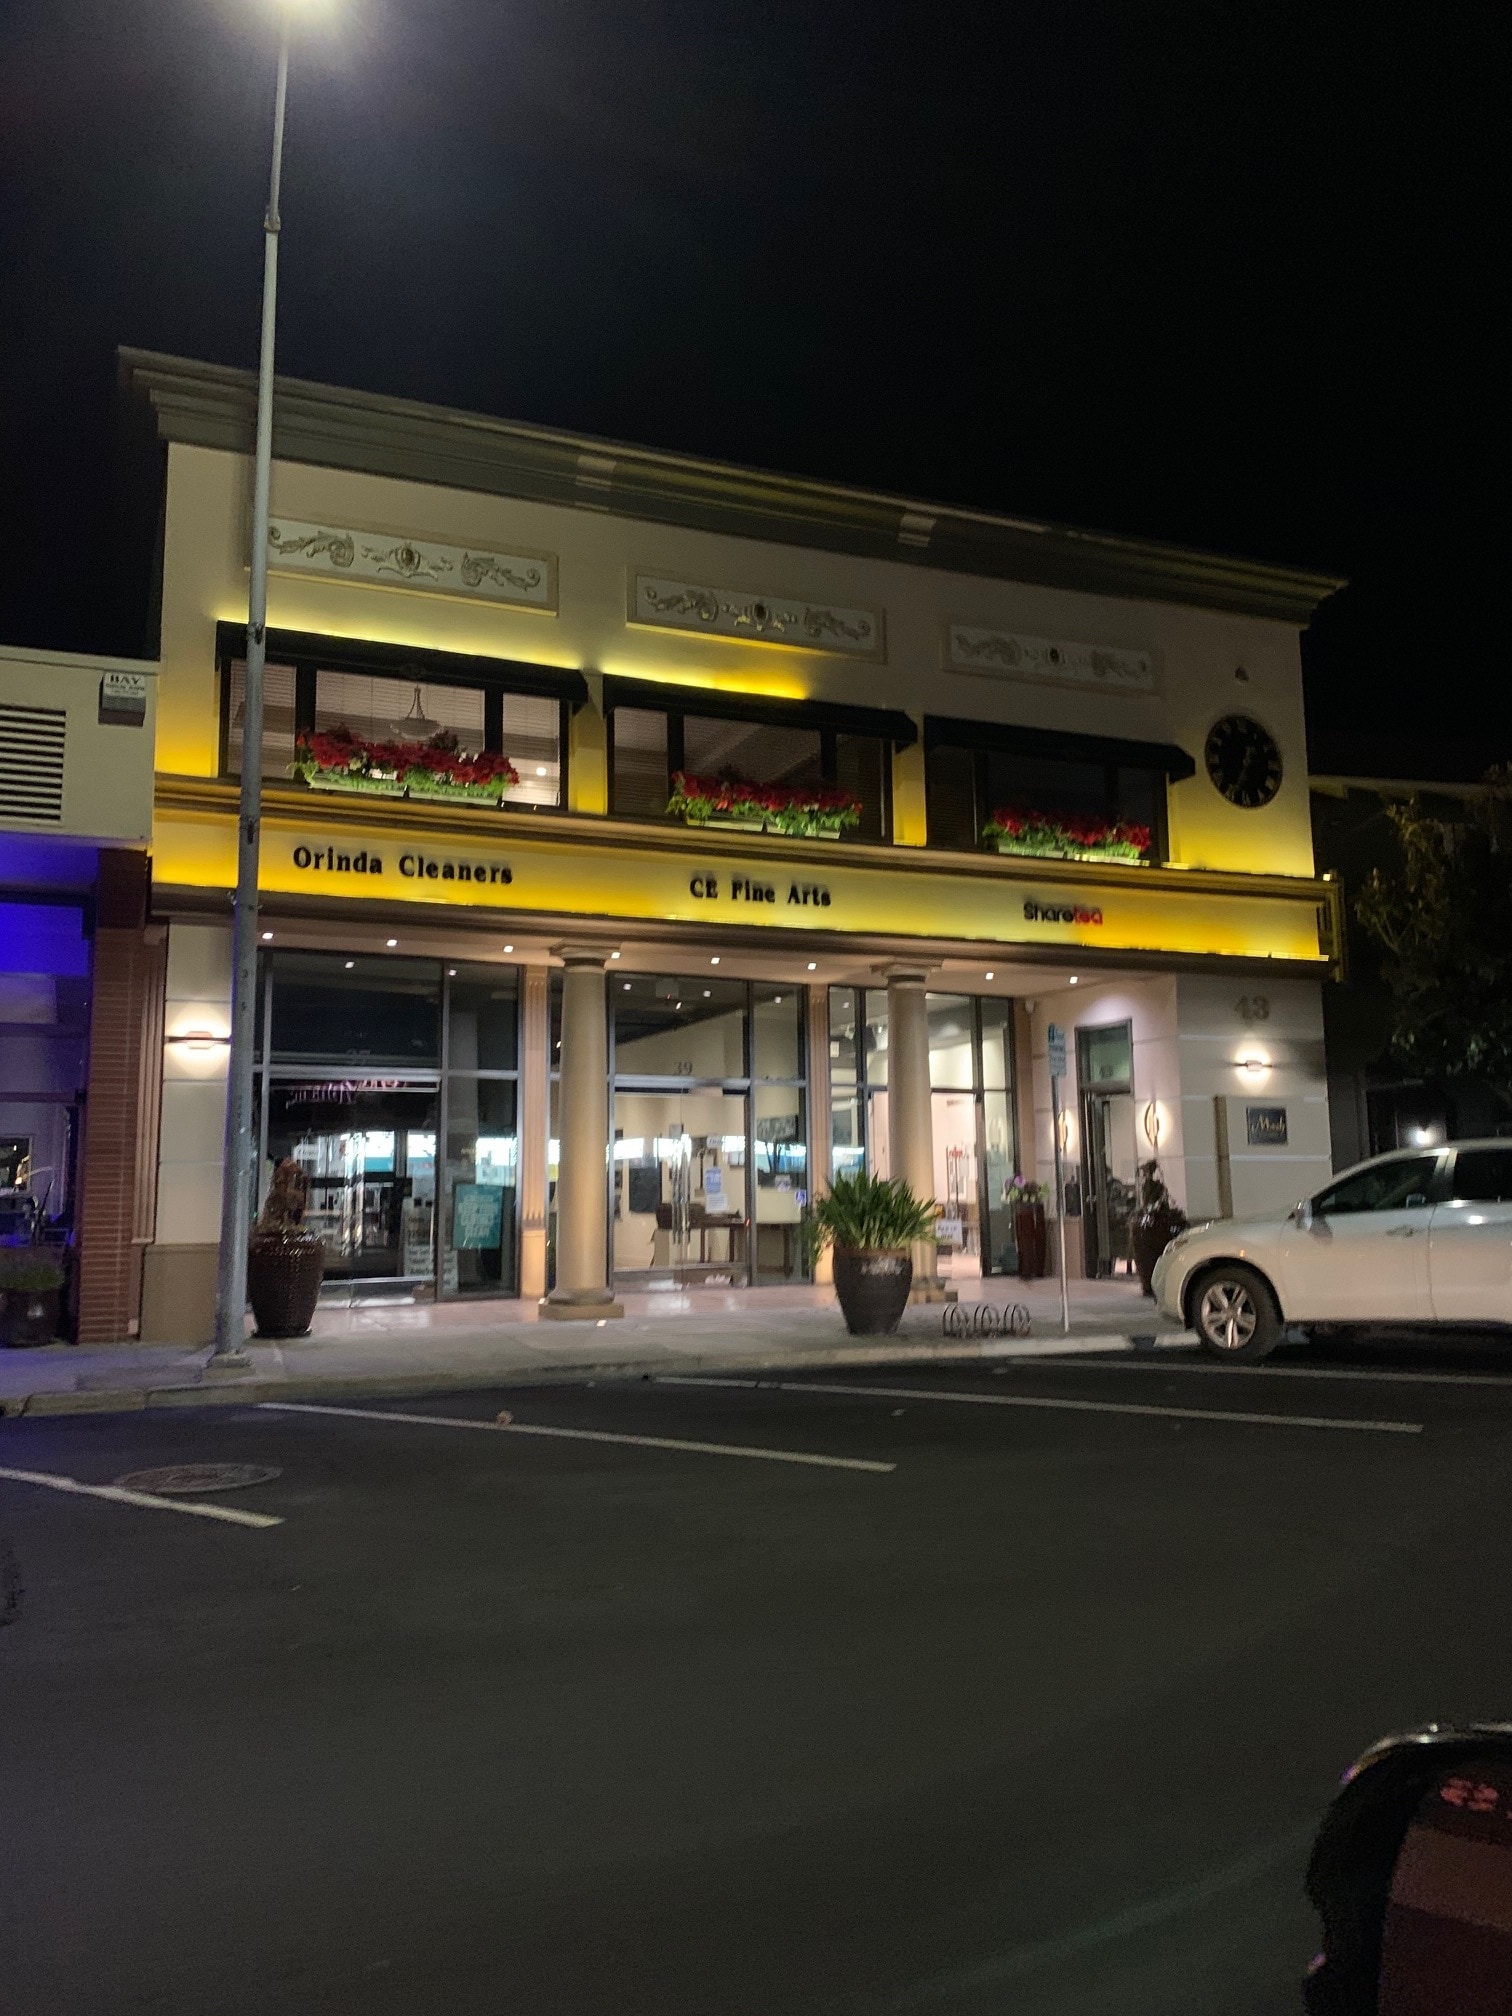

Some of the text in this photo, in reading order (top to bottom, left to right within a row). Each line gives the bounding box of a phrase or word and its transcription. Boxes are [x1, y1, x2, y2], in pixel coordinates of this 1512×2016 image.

[293, 845, 513, 884] Orinda Cleaners
[689, 876, 832, 907] CE Fine Arts
[1023, 900, 1104, 926] Sharetea
[674, 1061, 693, 1076] 39
